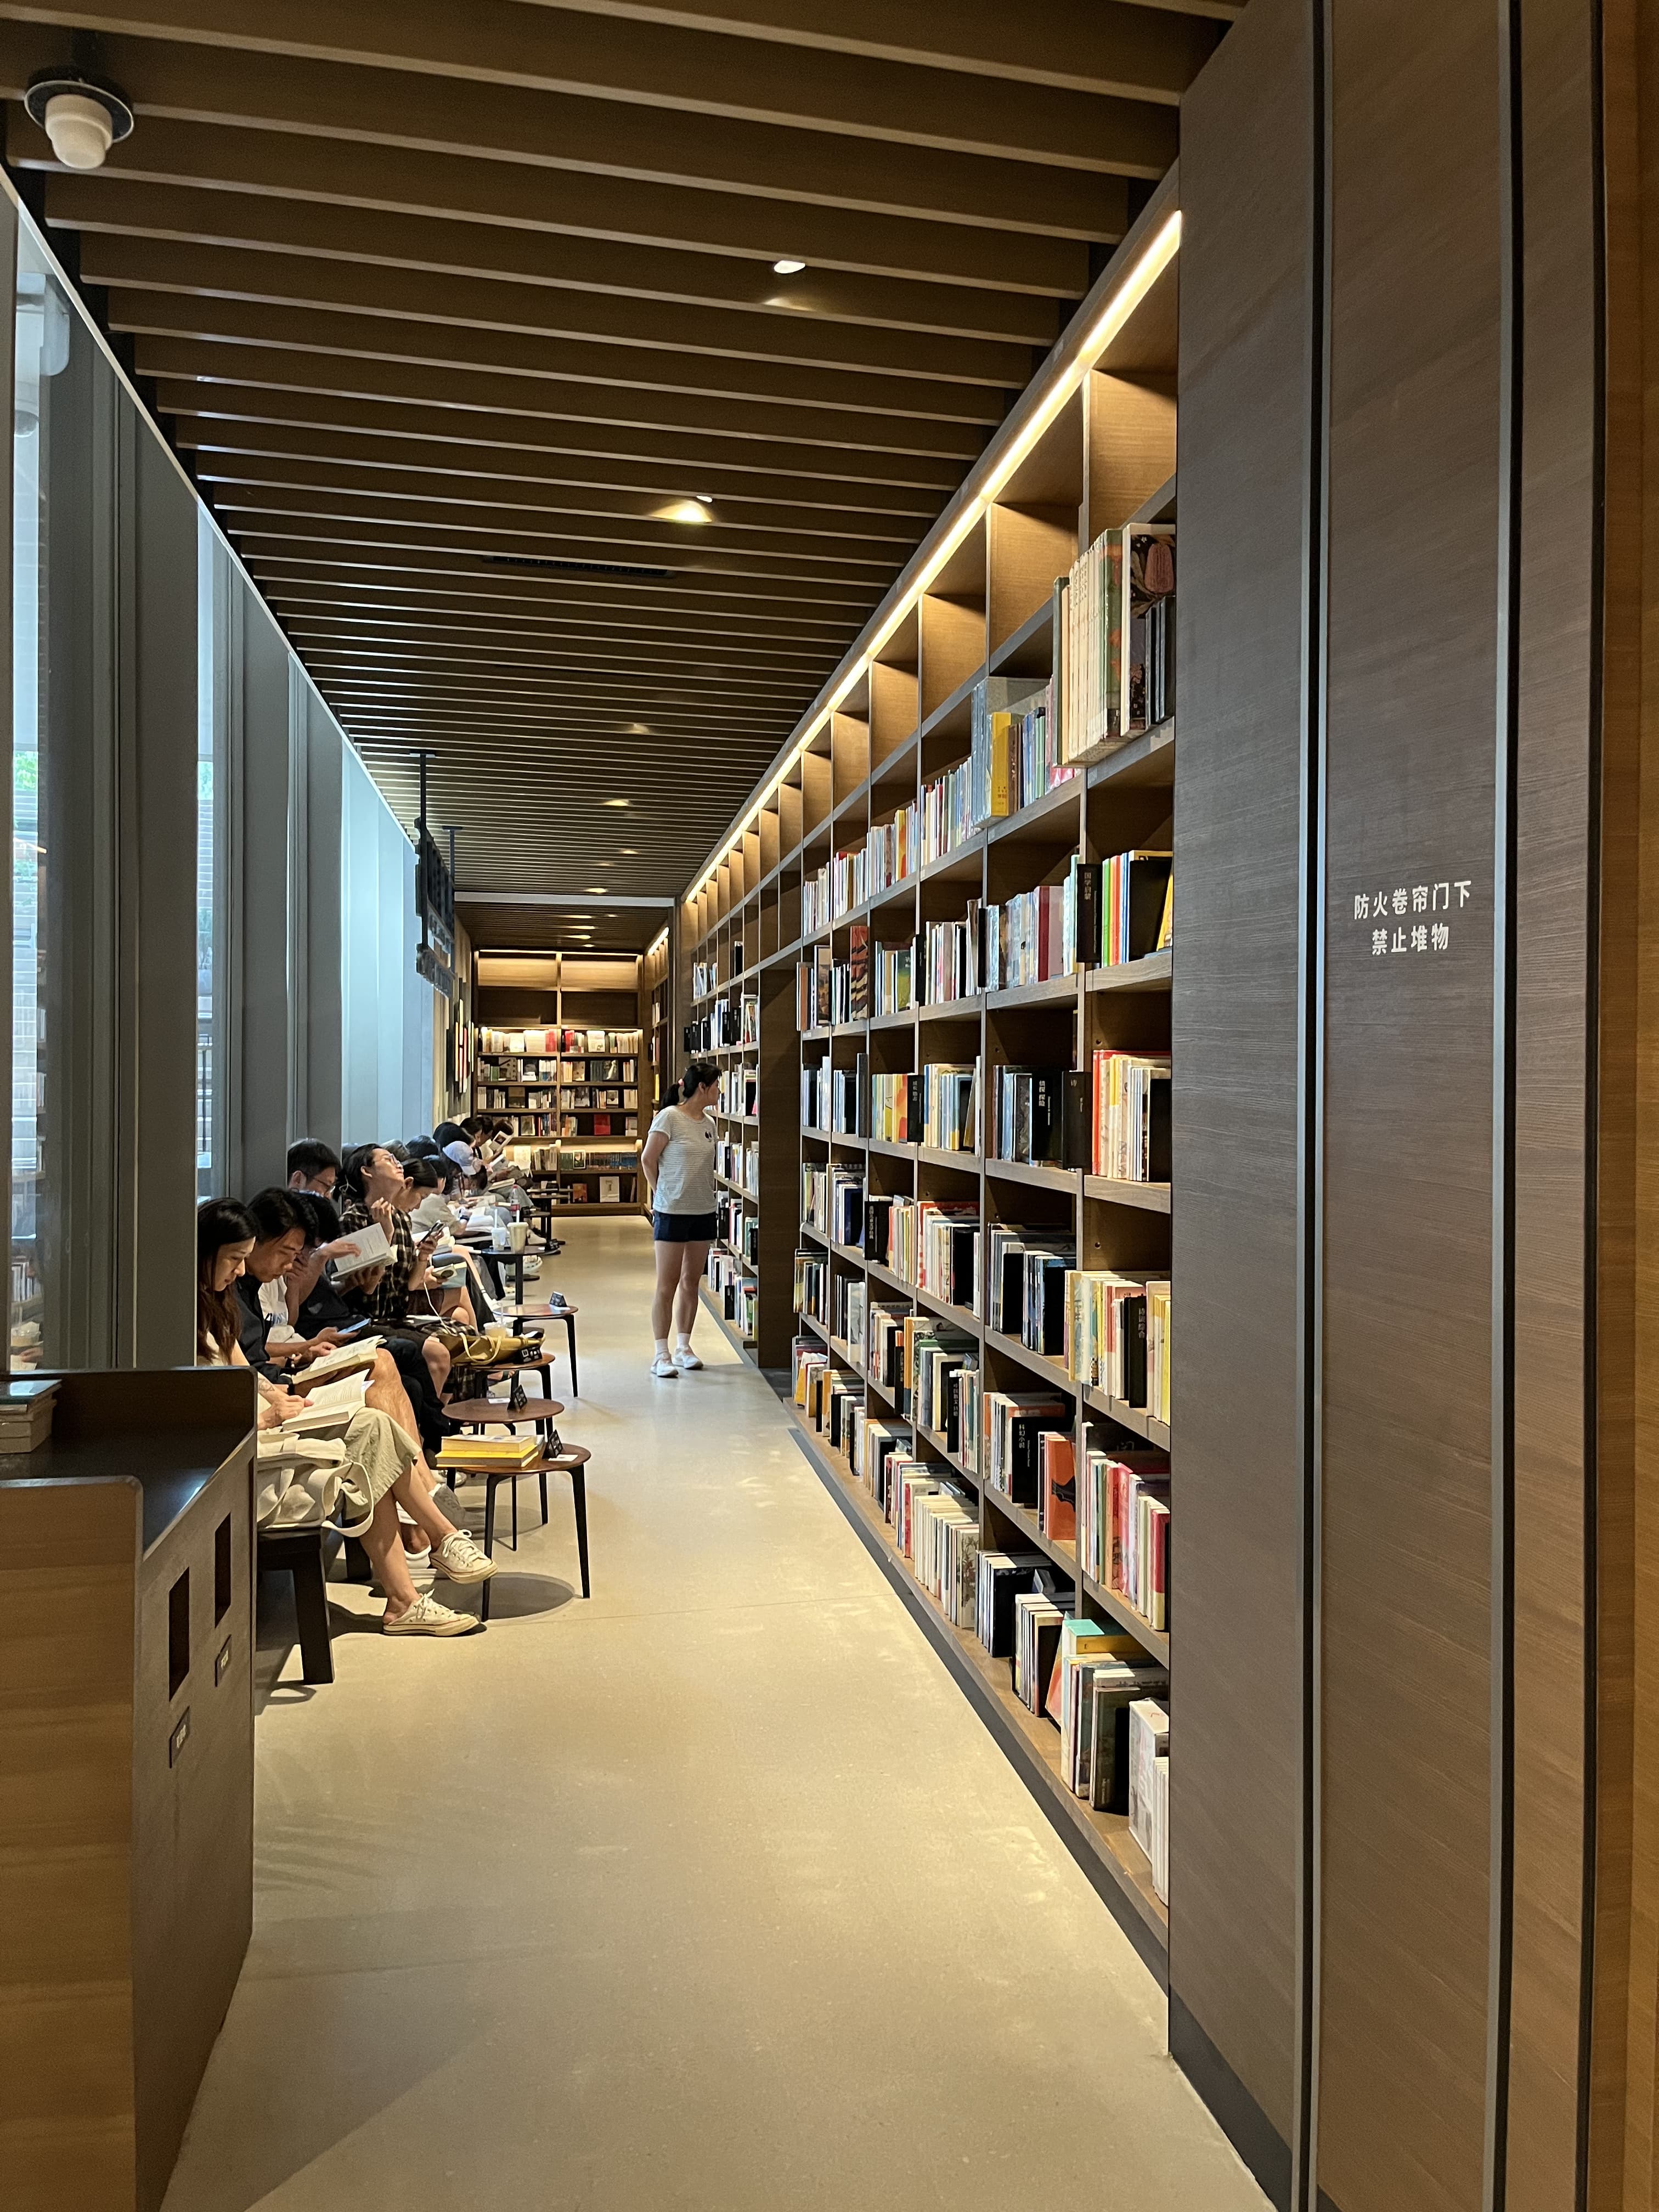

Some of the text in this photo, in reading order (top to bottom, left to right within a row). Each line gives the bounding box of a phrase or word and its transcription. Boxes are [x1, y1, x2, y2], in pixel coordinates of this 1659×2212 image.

[1353, 880, 1471, 920] 防火卷帘门下
[1372, 922, 1449, 956] 禁止堆物
